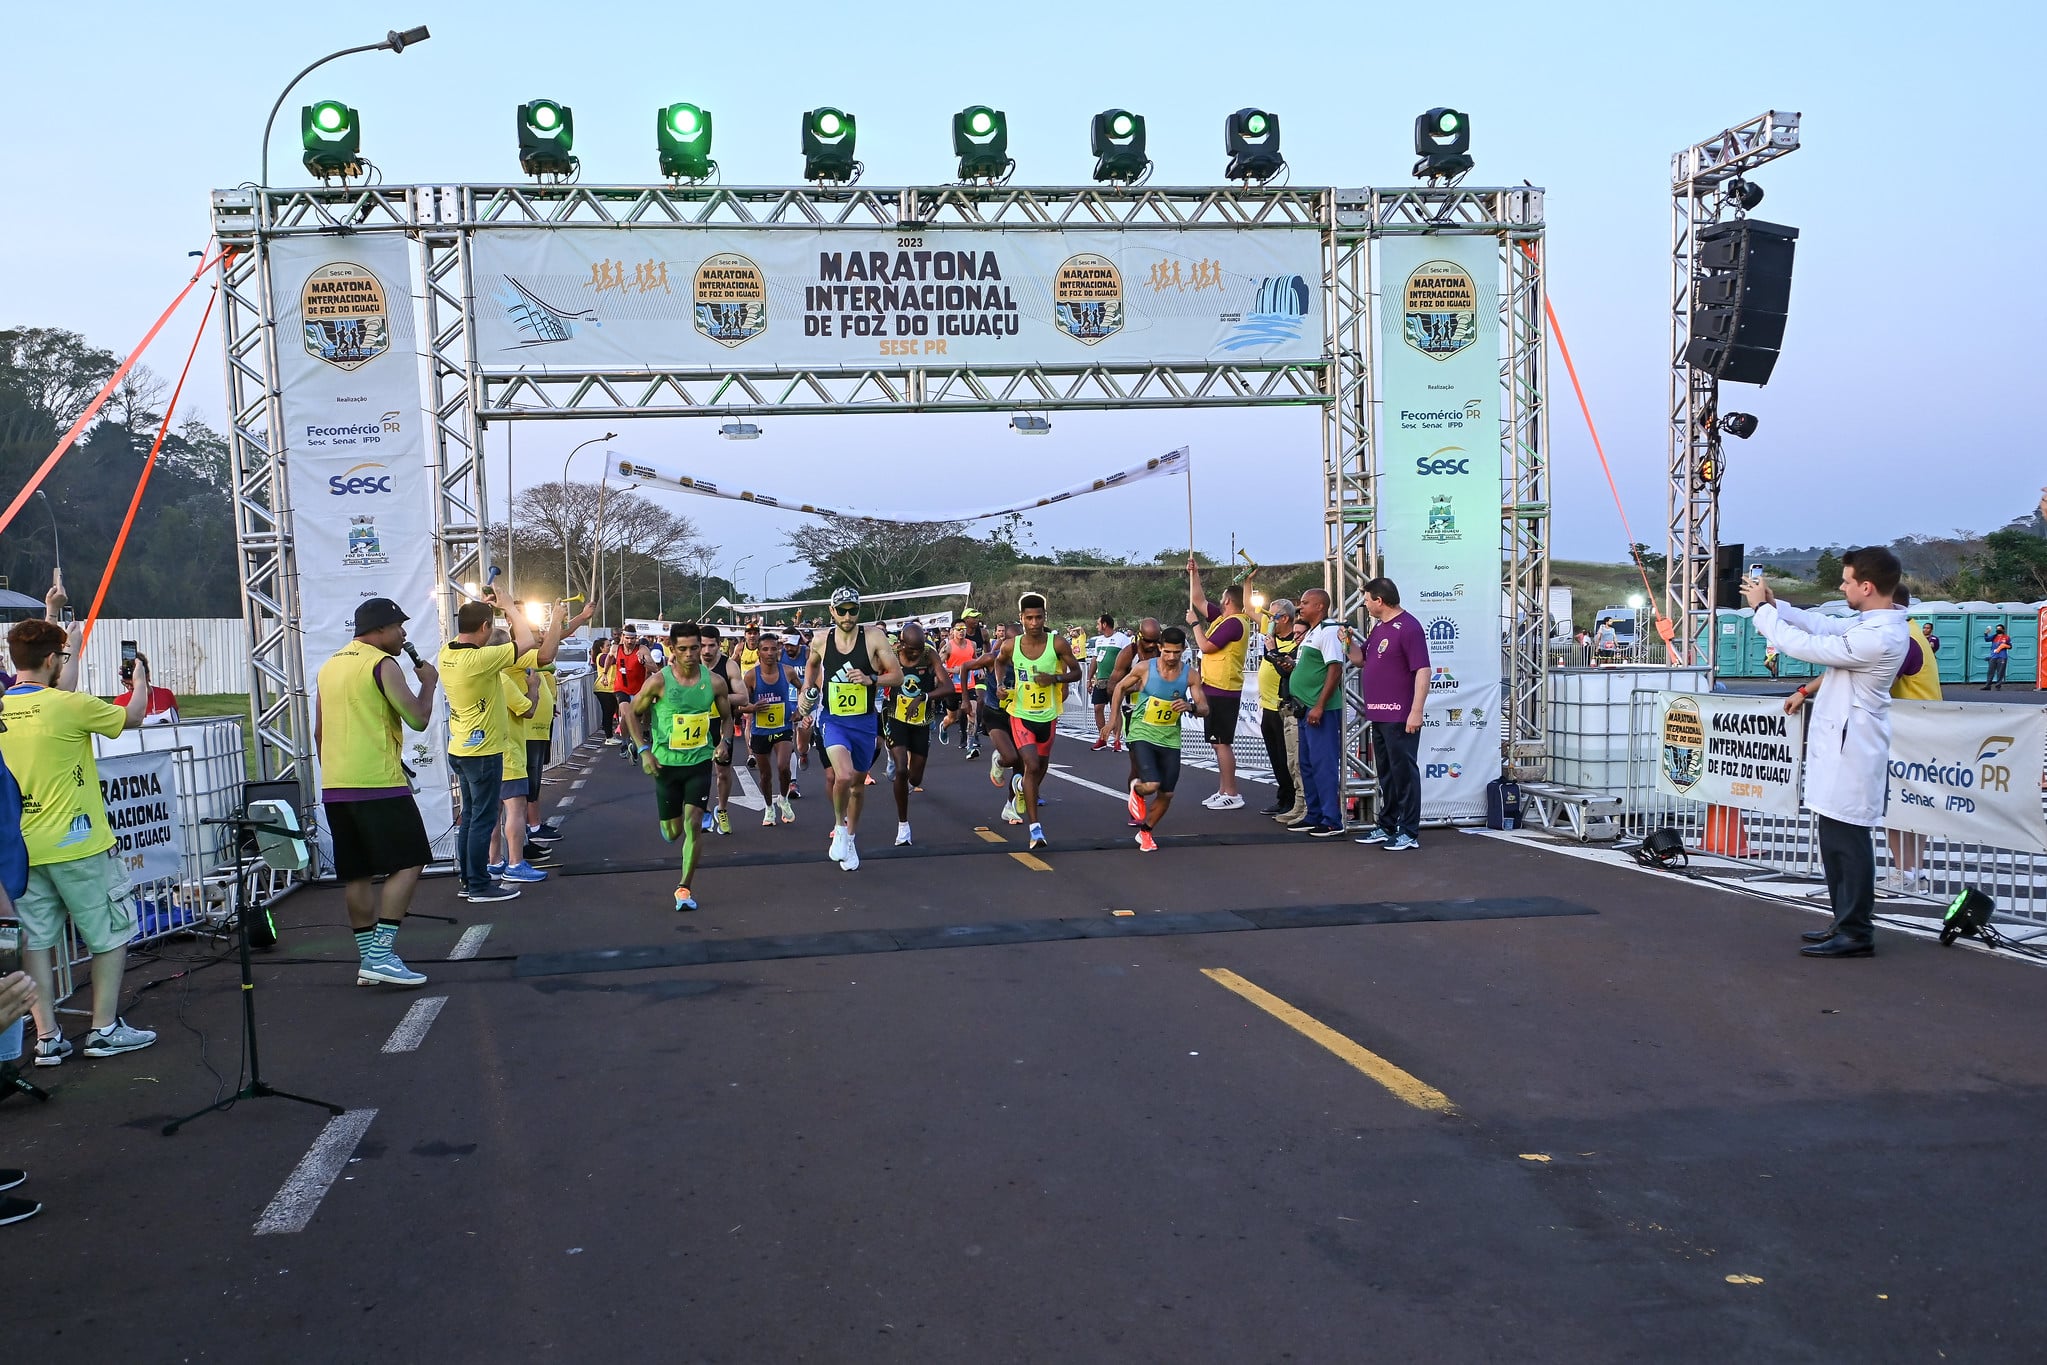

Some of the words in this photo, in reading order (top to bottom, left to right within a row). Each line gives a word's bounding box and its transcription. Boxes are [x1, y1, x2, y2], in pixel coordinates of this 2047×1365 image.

[897, 238, 923, 247] 2023
[820, 251, 1001, 284] MARATONA
[1064, 270, 1112, 279] MARATONA
[703, 271, 754, 280] MARATONA
[312, 281, 372, 294] MARATONA
[699, 282, 759, 290] INTERNACIONAL
[1414, 279, 1465, 289] MARATONA
[308, 294, 378, 306] INTERNACIONAL
[805, 285, 1016, 314] INTERNACIONAL
[1410, 291, 1470, 299] INTERNACIONAL
[320, 306, 336, 314] FOZ
[352, 304, 380, 313] IGUAÇU
[804, 316, 832, 336] DE
[841, 315, 887, 338] FOZ
[896, 315, 928, 336] DO
[938, 314, 1018, 339] IGUAÇU
[880, 340, 918, 355] SESC
[925, 339, 947, 354] PR
[1401, 410, 1462, 420] Fecomércio
[1466, 410, 1480, 419] PR
[307, 423, 380, 437] Fecomércio
[384, 423, 400, 433] PR
[1417, 457, 1469, 475] Sesc
[329, 475, 391, 496] Sesc
[838, 695, 856, 707] 20
[1030, 693, 1045, 704] 15
[768, 713, 775, 722] 6
[1156, 710, 1172, 720] 18
[1668, 713, 1697, 724] MARATONA
[1713, 713, 1786, 737] MARATONA
[683, 726, 700, 740] 14
[1709, 737, 1792, 763] INTERNACIONAL
[1426, 763, 1462, 778] RPC
[1708, 759, 1718, 774] DE
[1721, 760, 1738, 776] FOZ
[1741, 763, 1753, 778] DO
[1756, 766, 1791, 786] IGUAÇU
[1888, 757, 1974, 788] comércio
[1980, 764, 2010, 792] PR
[99, 773, 161, 805] RATONA
[1731, 782, 1750, 796] SESC
[1752, 784, 1762, 798] PR
[1901, 789, 1935, 808] Senac
[1946, 795, 1975, 813] IFPD
[106, 802, 169, 830] NACIONAL
[134, 825, 170, 848] IGUAÇU
[131, 854, 144, 871] PR
